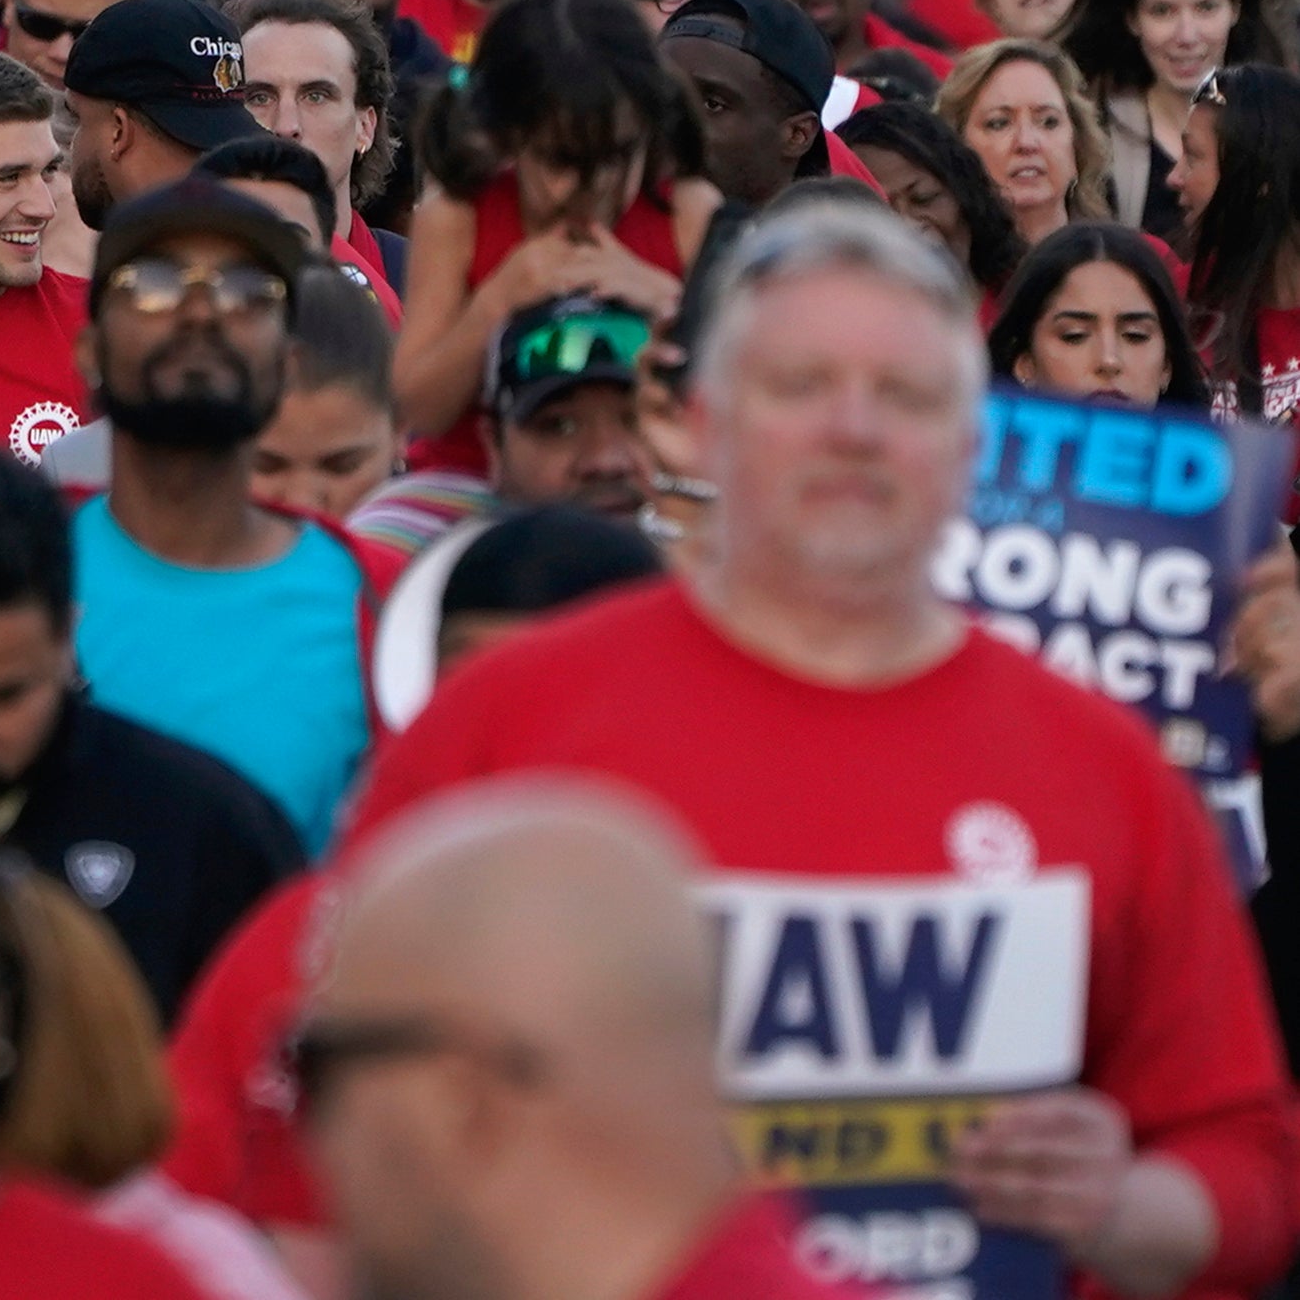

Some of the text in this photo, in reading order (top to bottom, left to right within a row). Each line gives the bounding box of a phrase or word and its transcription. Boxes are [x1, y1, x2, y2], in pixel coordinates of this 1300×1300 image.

[30, 428, 63, 446] UAW
[974, 400, 1233, 517] ITED
[930, 518, 1214, 637] RONG
[739, 906, 1003, 1066] AW
[794, 1207, 981, 1285] ORD
